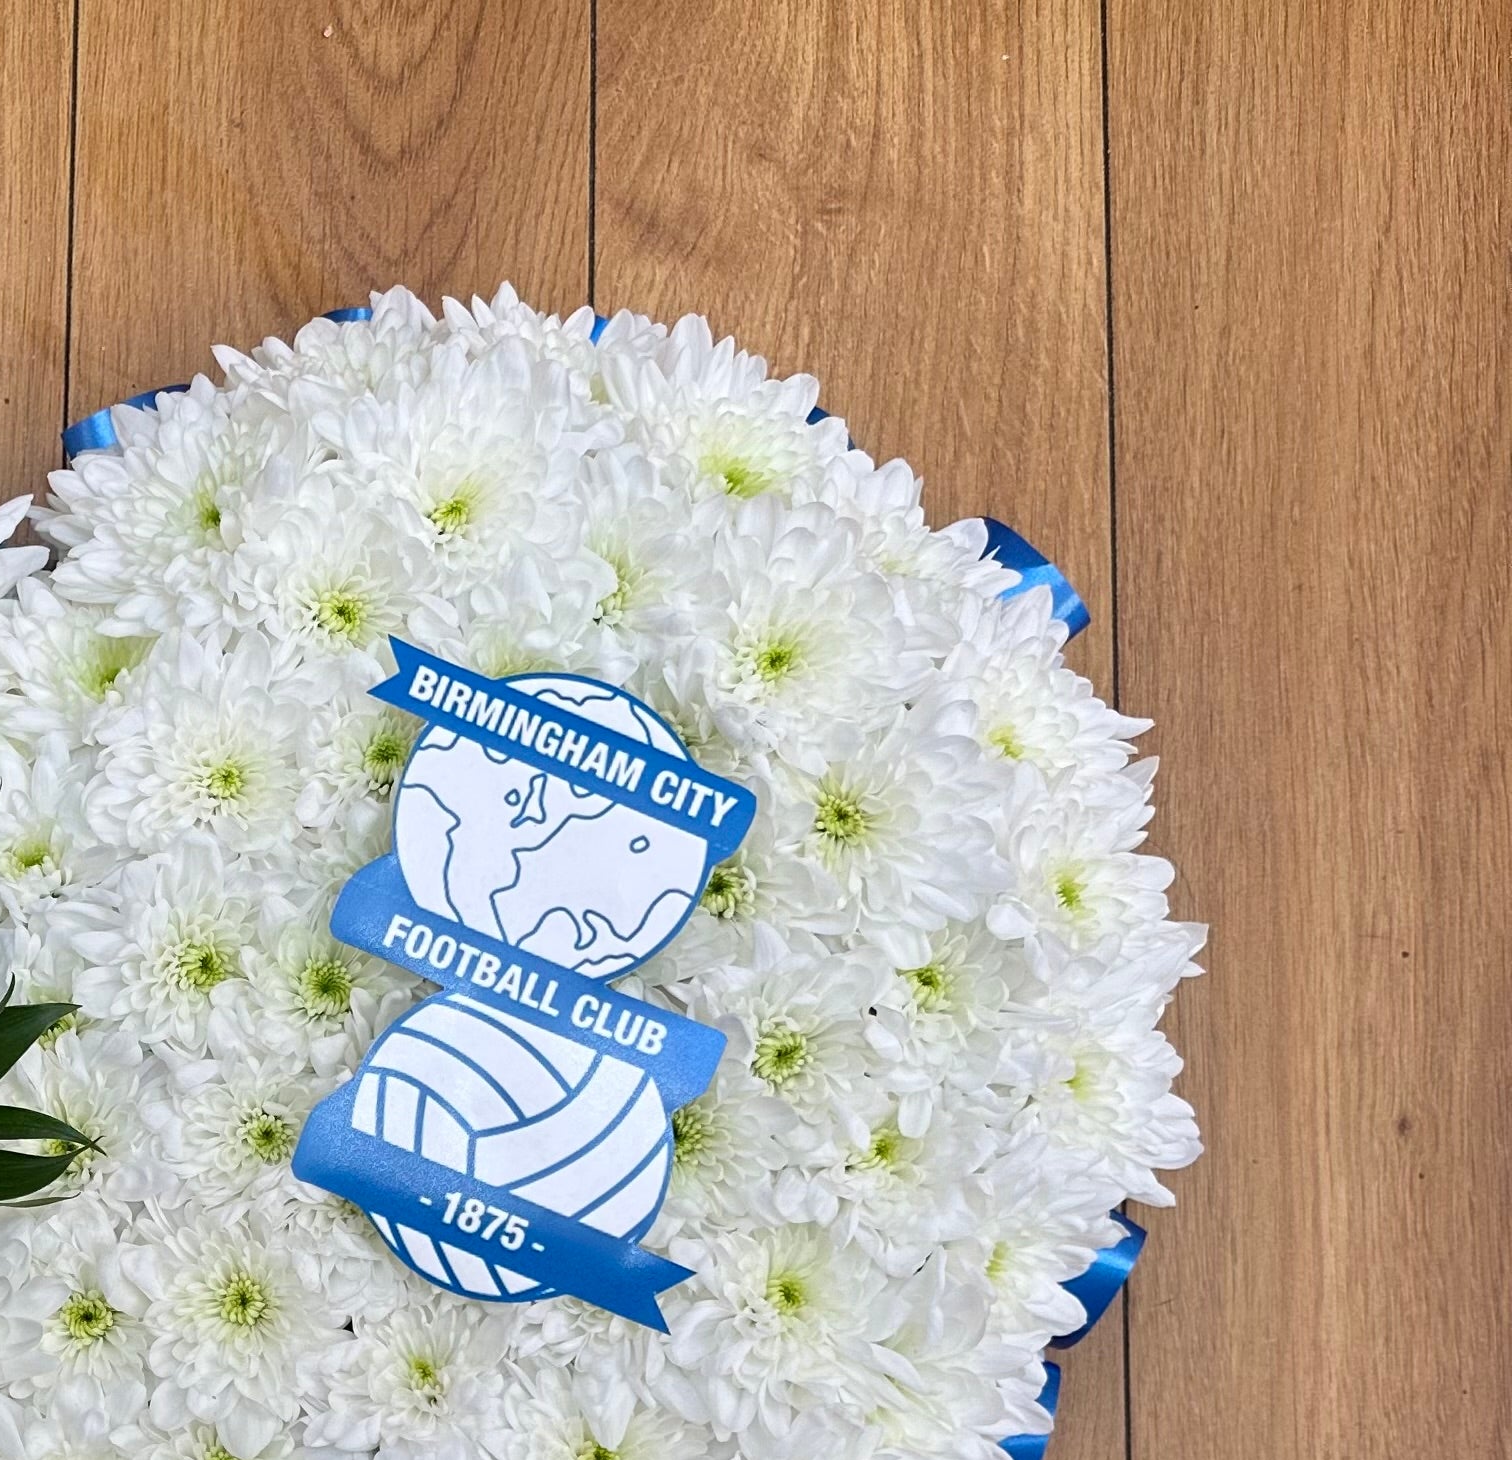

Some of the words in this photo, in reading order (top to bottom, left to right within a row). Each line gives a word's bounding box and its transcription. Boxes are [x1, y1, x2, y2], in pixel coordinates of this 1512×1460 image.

[408, 664, 646, 793] BIRMINGHAM
[650, 770, 739, 828] CITY
[384, 914, 560, 1018] FOOTBALL
[571, 994, 667, 1056] CLUB
